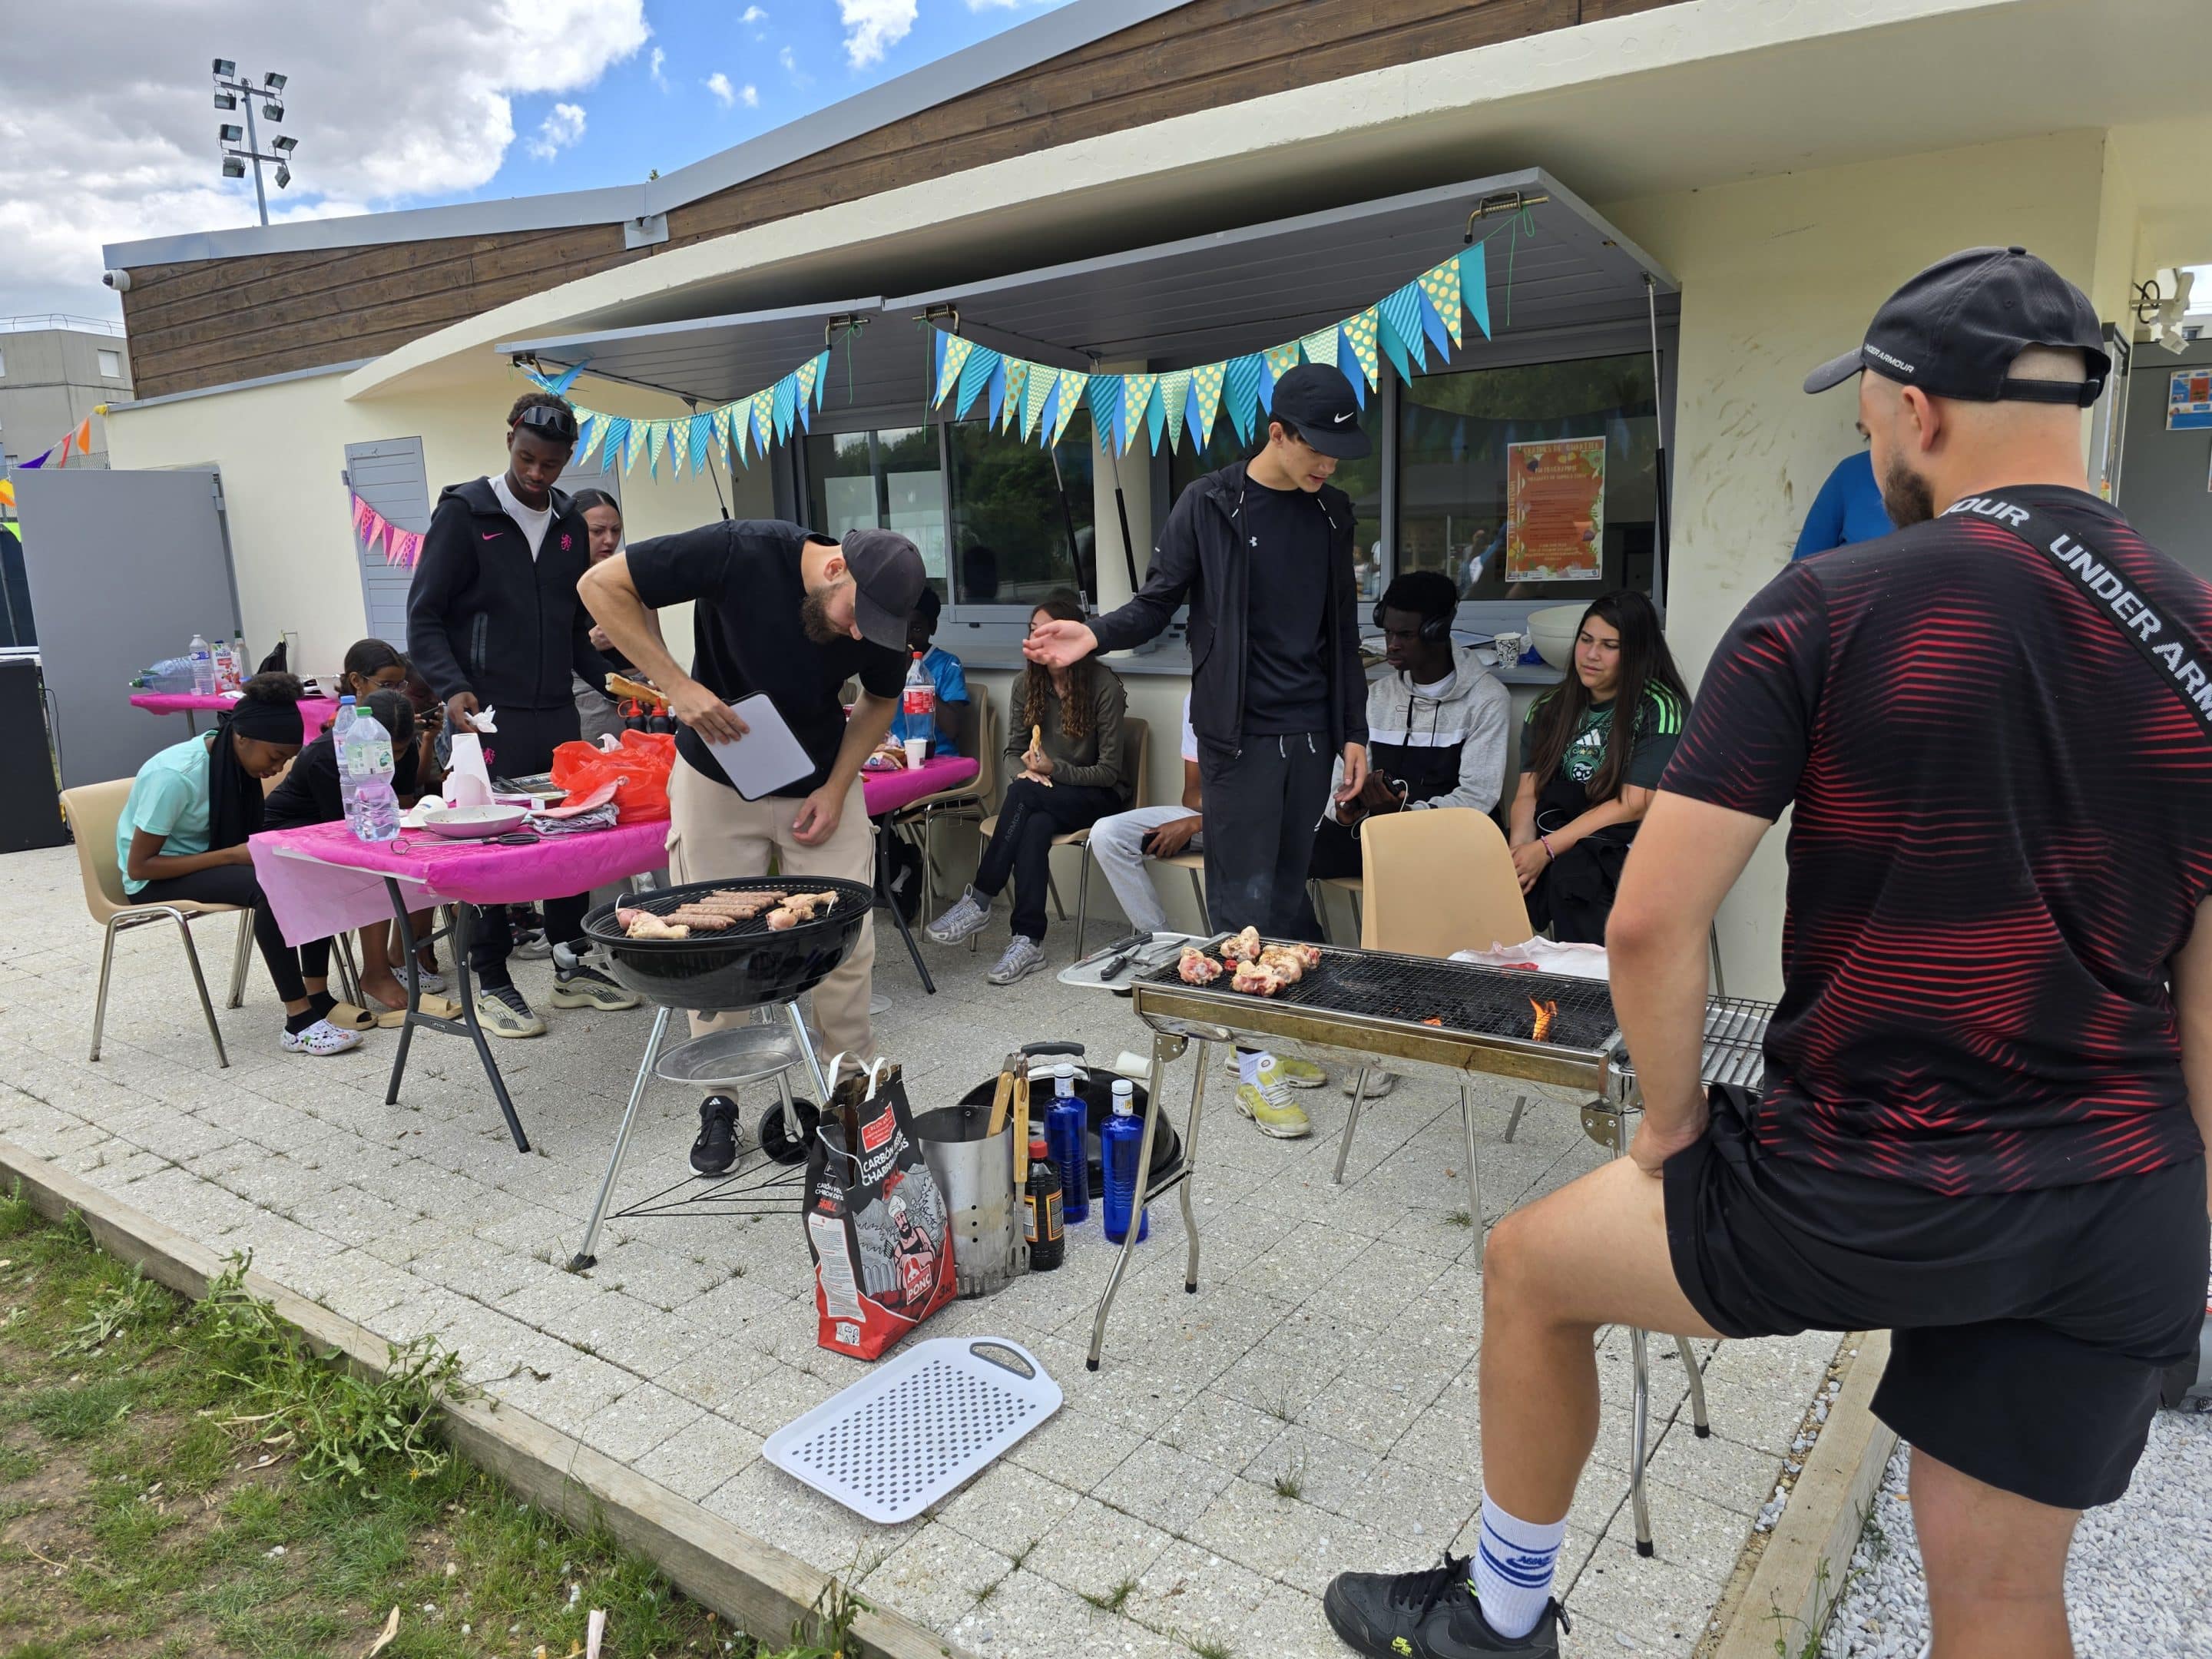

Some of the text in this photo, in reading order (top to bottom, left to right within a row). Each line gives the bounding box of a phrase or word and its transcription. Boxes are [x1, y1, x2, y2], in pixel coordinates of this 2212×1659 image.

[1877, 352, 1915, 373] ARMOUR
[1939, 497, 2030, 527] OUR
[2049, 534, 2162, 642] UNDER
[908, 1273, 931, 1300] PONC
